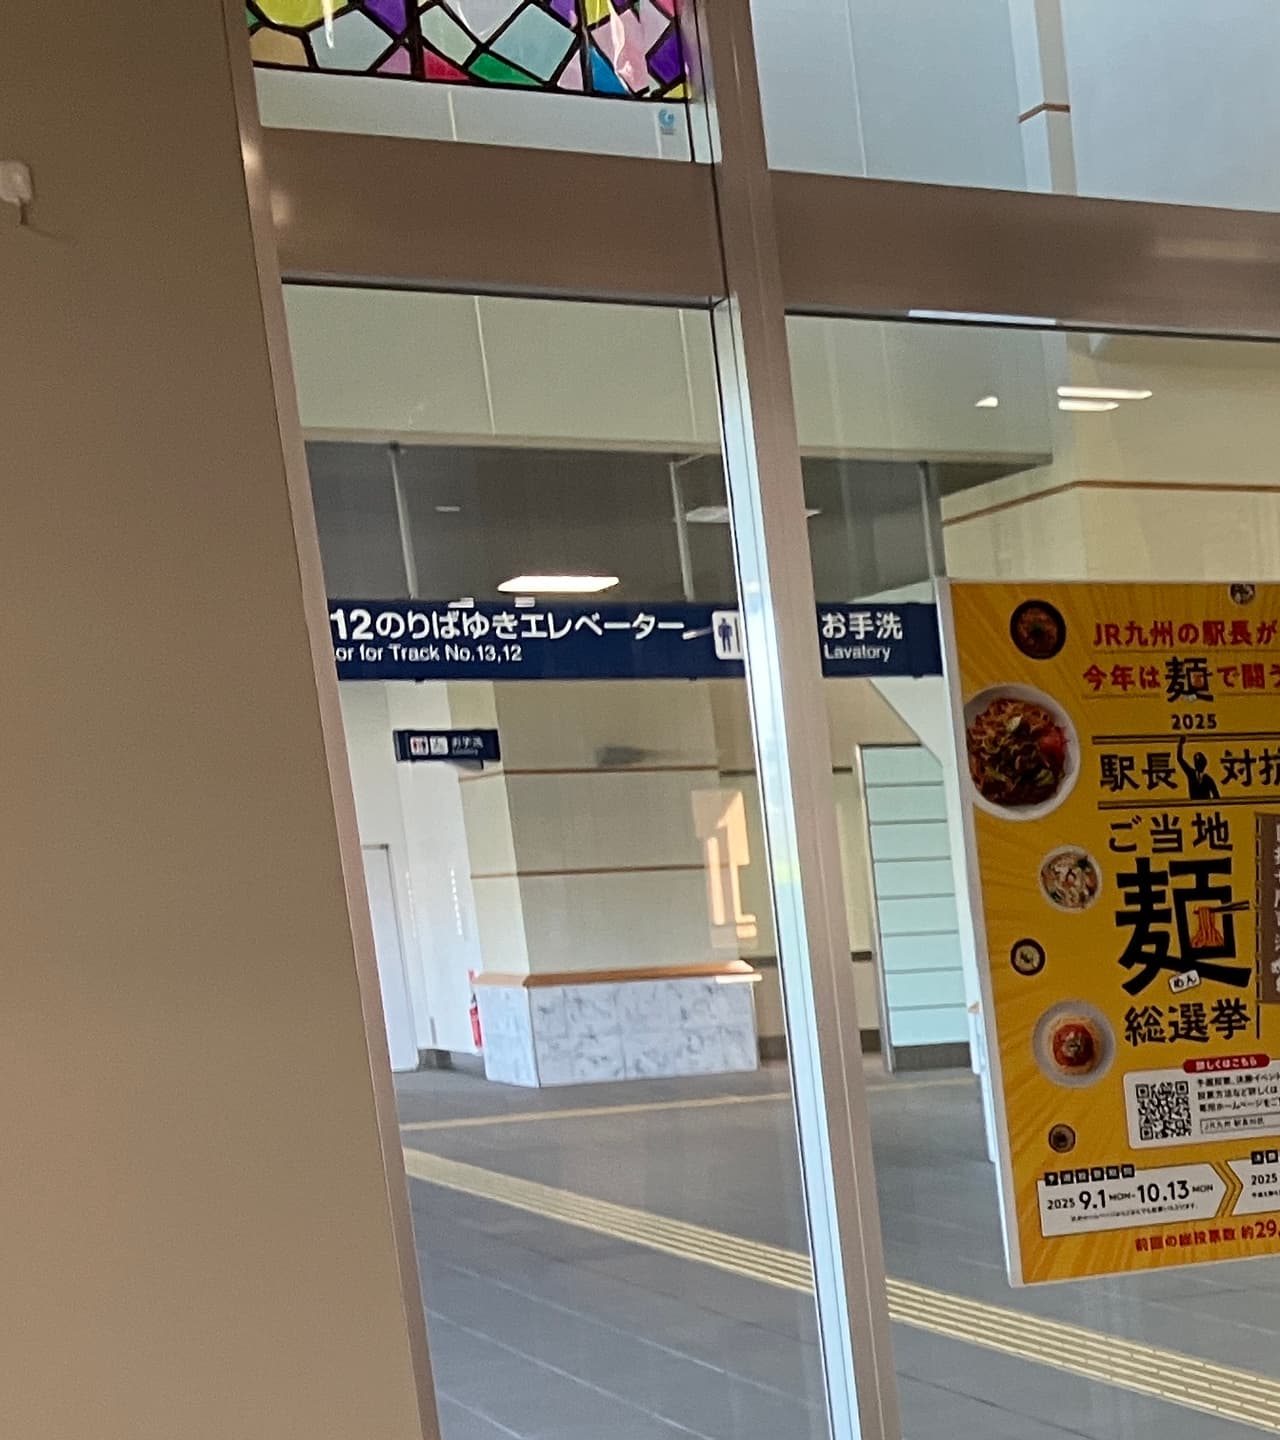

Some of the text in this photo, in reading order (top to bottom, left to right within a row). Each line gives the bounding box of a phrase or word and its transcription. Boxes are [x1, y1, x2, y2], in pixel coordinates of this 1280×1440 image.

[821, 611, 904, 640] お手洗
[1093, 619, 1278, 648] JR九州の駅長が
[359, 643, 383, 662] for
[388, 643, 440, 662] Track
[823, 643, 892, 663] Lavatory
[1171, 713, 1217, 730] 2025
[1108, 811, 1233, 853] ご当地
[1115, 857, 1252, 996] 麺
[1124, 997, 1251, 1047] 総選挙
[1195, 1056, 1258, 1071] 詳しくはこちら
[1251, 1173, 1278, 1186] 2025
[1047, 1198, 1076, 1211] 2025
[1078, 1189, 1107, 1211] 9.1
[1137, 1180, 1190, 1203] 10.13
